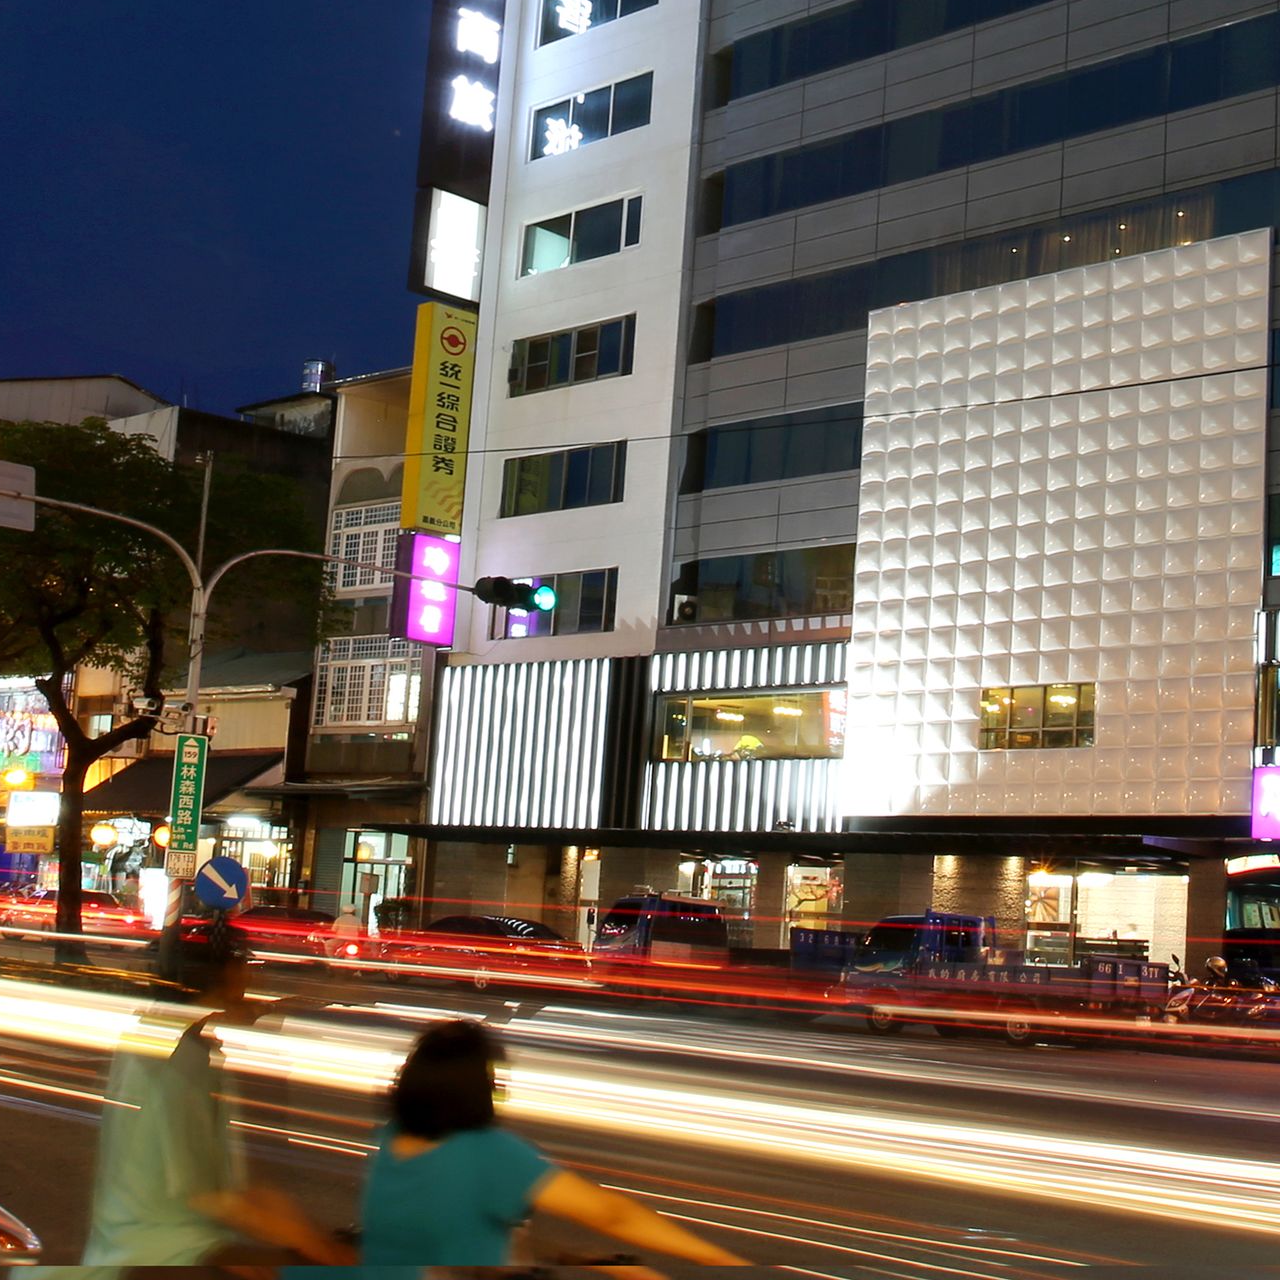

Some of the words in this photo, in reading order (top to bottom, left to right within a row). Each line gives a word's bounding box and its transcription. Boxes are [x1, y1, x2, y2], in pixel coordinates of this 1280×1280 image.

[431, 360, 463, 476] 統一綜合證券
[184, 750, 198, 759] 159
[176, 765, 197, 825] 林森西路
